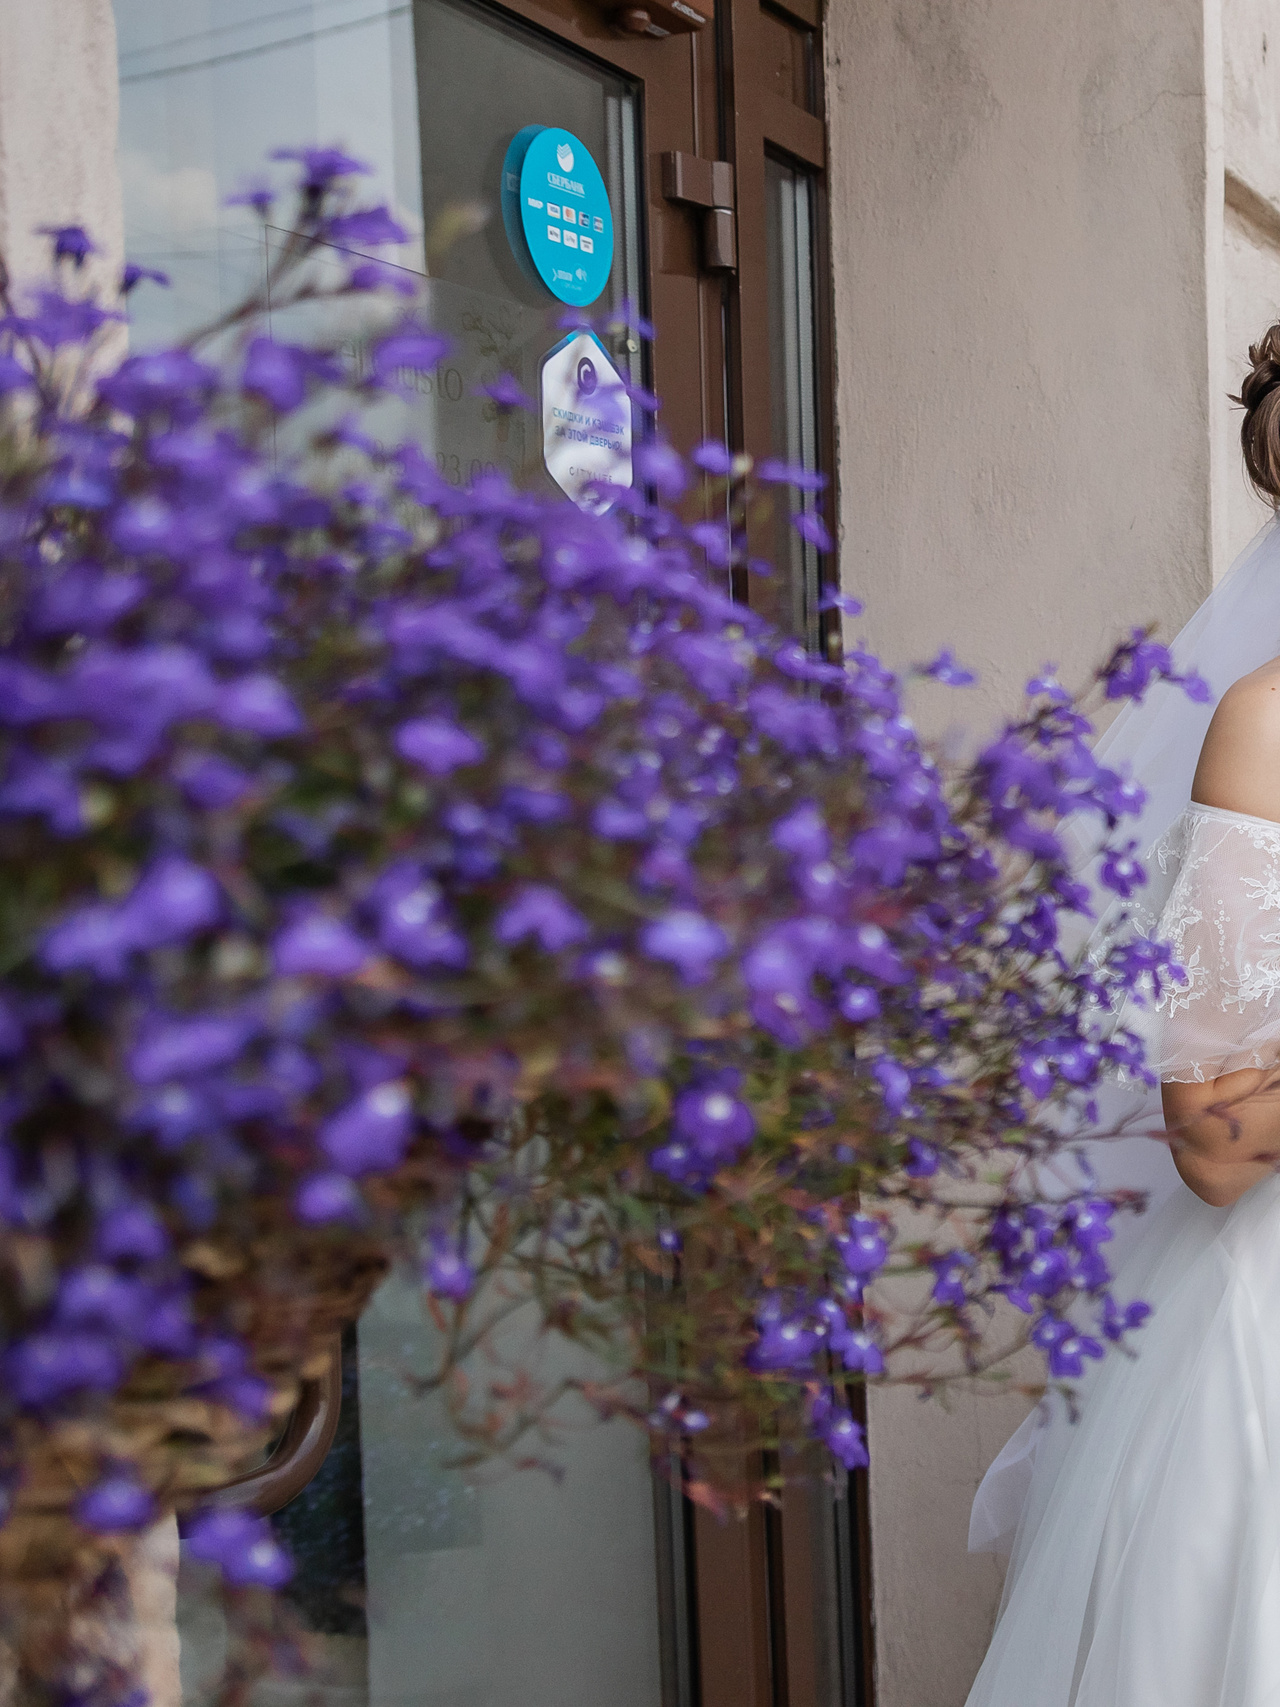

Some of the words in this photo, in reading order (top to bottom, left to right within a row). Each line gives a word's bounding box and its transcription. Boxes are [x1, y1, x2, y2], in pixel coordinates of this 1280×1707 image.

[547, 172, 585, 195] СБЕРБАНК
[552, 407, 583, 423] СКИДКИ
[585, 416, 591, 426] И
[554, 425, 566, 438] ЗА
[568, 428, 588, 443] ЭТОЙ
